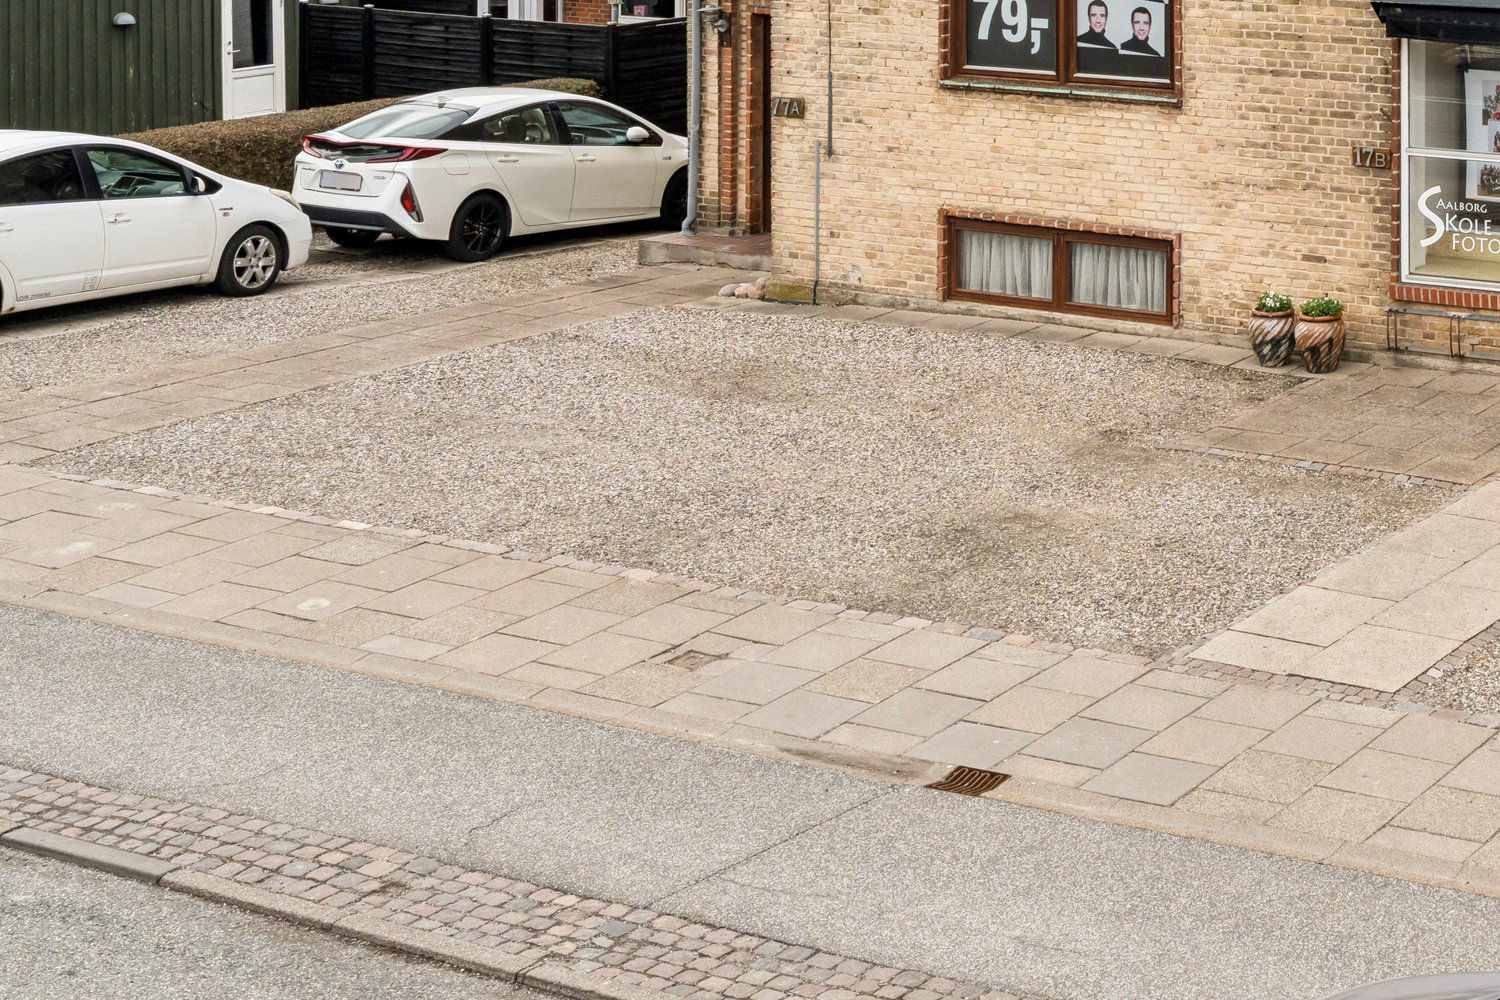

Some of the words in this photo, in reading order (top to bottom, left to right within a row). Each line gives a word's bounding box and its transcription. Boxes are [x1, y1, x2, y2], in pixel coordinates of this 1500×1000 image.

[773, 98, 800, 116] 17A
[1353, 146, 1386, 168] 17B
[1436, 198, 1488, 213] AALBORG
